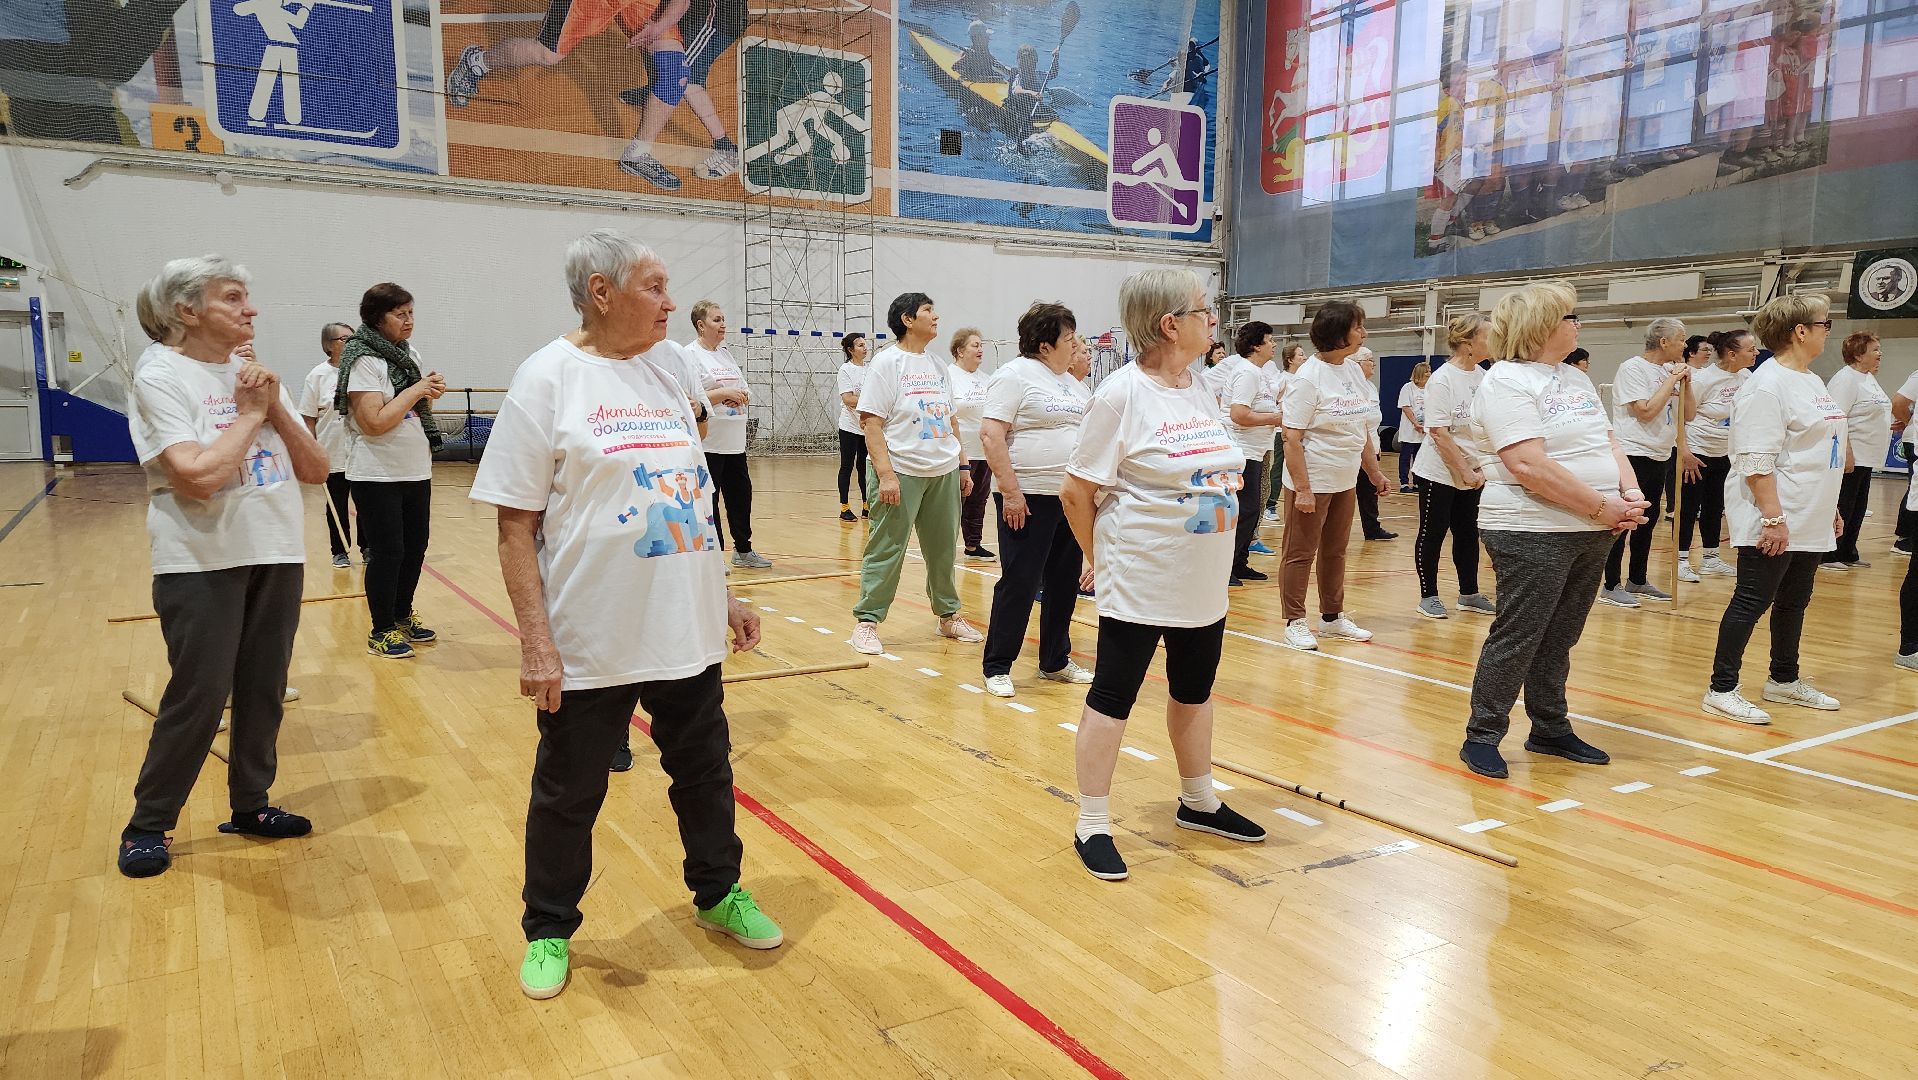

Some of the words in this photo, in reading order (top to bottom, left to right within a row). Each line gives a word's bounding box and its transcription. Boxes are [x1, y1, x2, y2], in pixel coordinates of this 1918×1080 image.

[587, 403, 673, 423] Активное
[593, 419, 682, 437] долголетие
[1155, 416, 1216, 436] Активное
